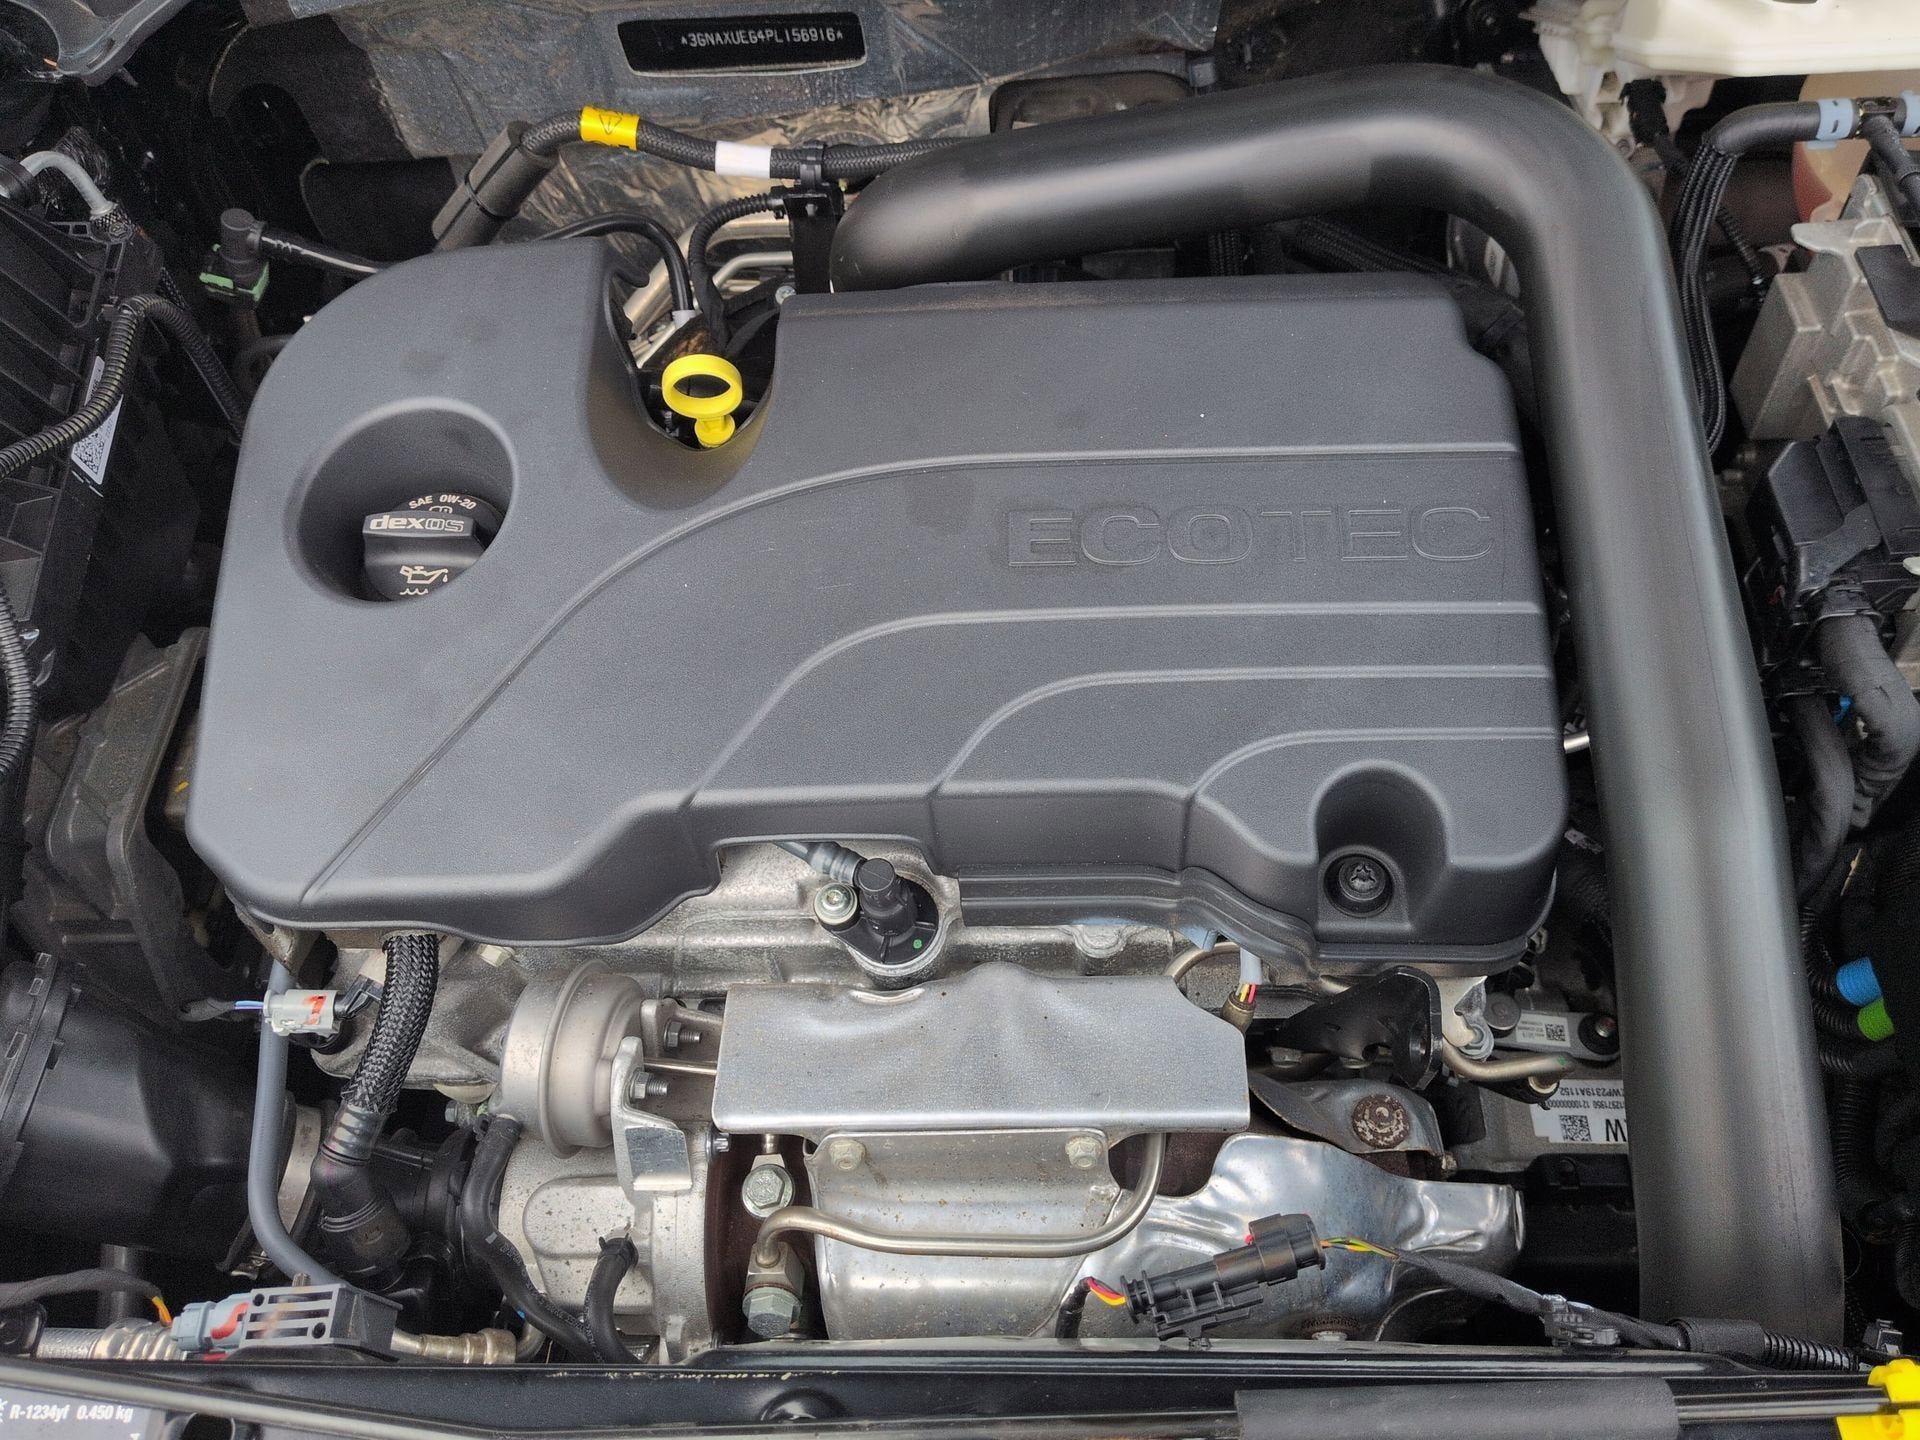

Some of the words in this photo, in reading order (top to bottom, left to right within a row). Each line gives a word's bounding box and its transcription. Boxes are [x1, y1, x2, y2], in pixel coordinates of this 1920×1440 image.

[408, 495, 433, 509] SAE
[439, 494, 477, 510] 0W-20
[369, 515, 465, 532] dexos
[1007, 503, 1494, 567] ECOTEC
[9, 1404, 71, 1422] R-1234yf
[76, 1404, 114, 1420] 0.450
[115, 1405, 134, 1424] kg
